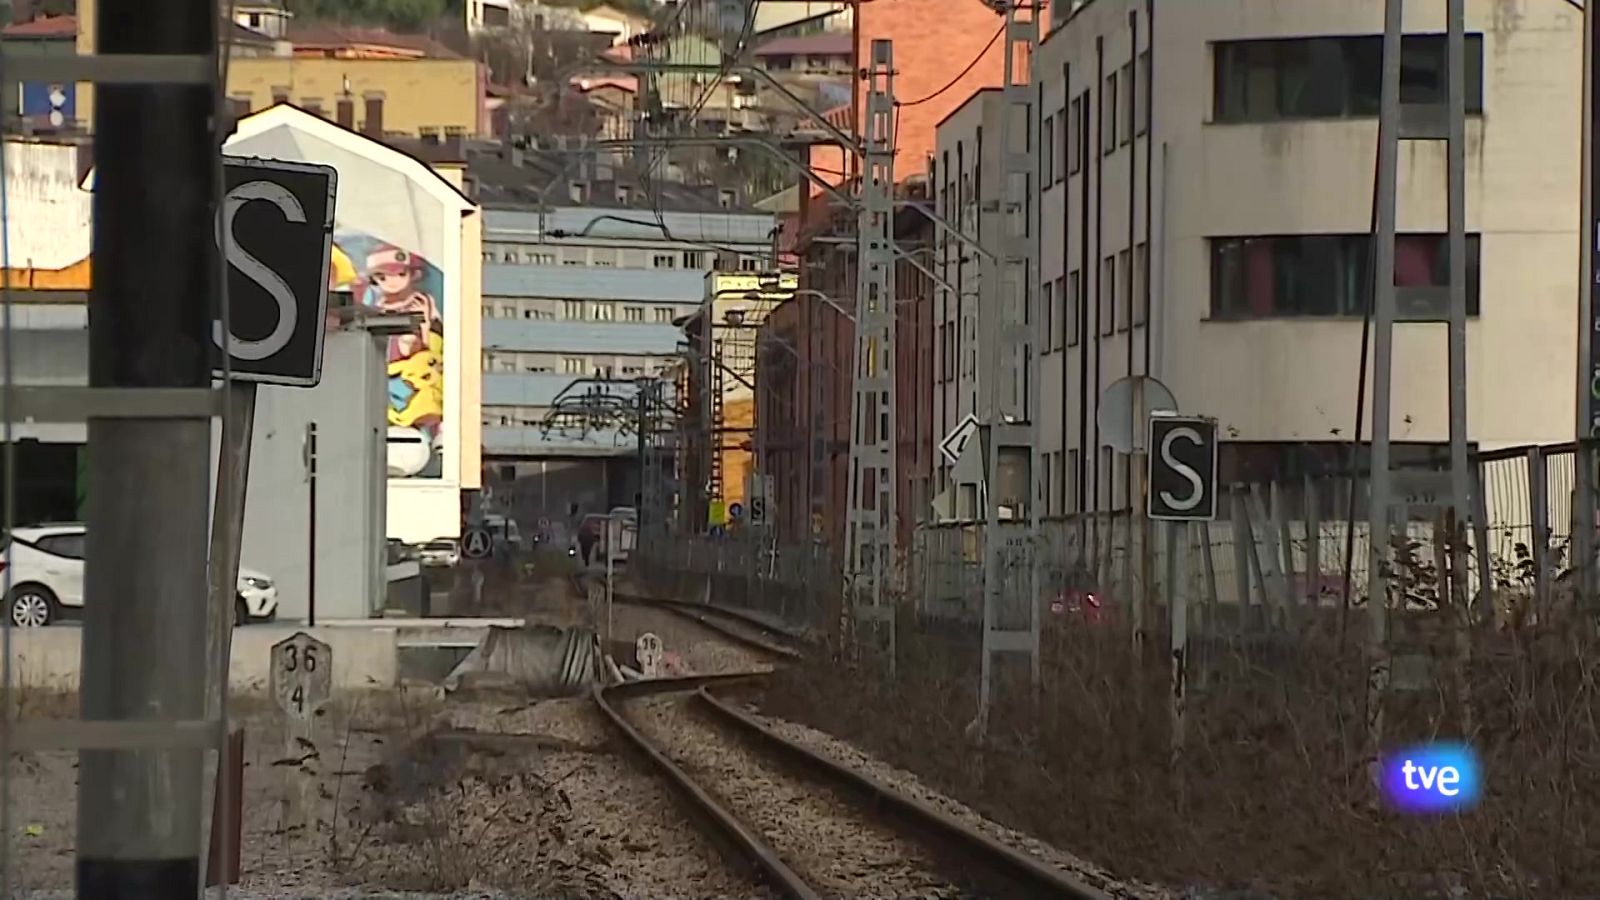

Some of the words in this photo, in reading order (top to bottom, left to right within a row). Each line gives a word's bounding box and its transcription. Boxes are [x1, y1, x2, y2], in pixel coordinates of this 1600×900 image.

[211, 180, 307, 361] S
[1160, 427, 1204, 511] S
[753, 498, 763, 518] S
[469, 531, 485, 552] A
[284, 644, 317, 673] 36
[291, 684, 304, 713] 4
